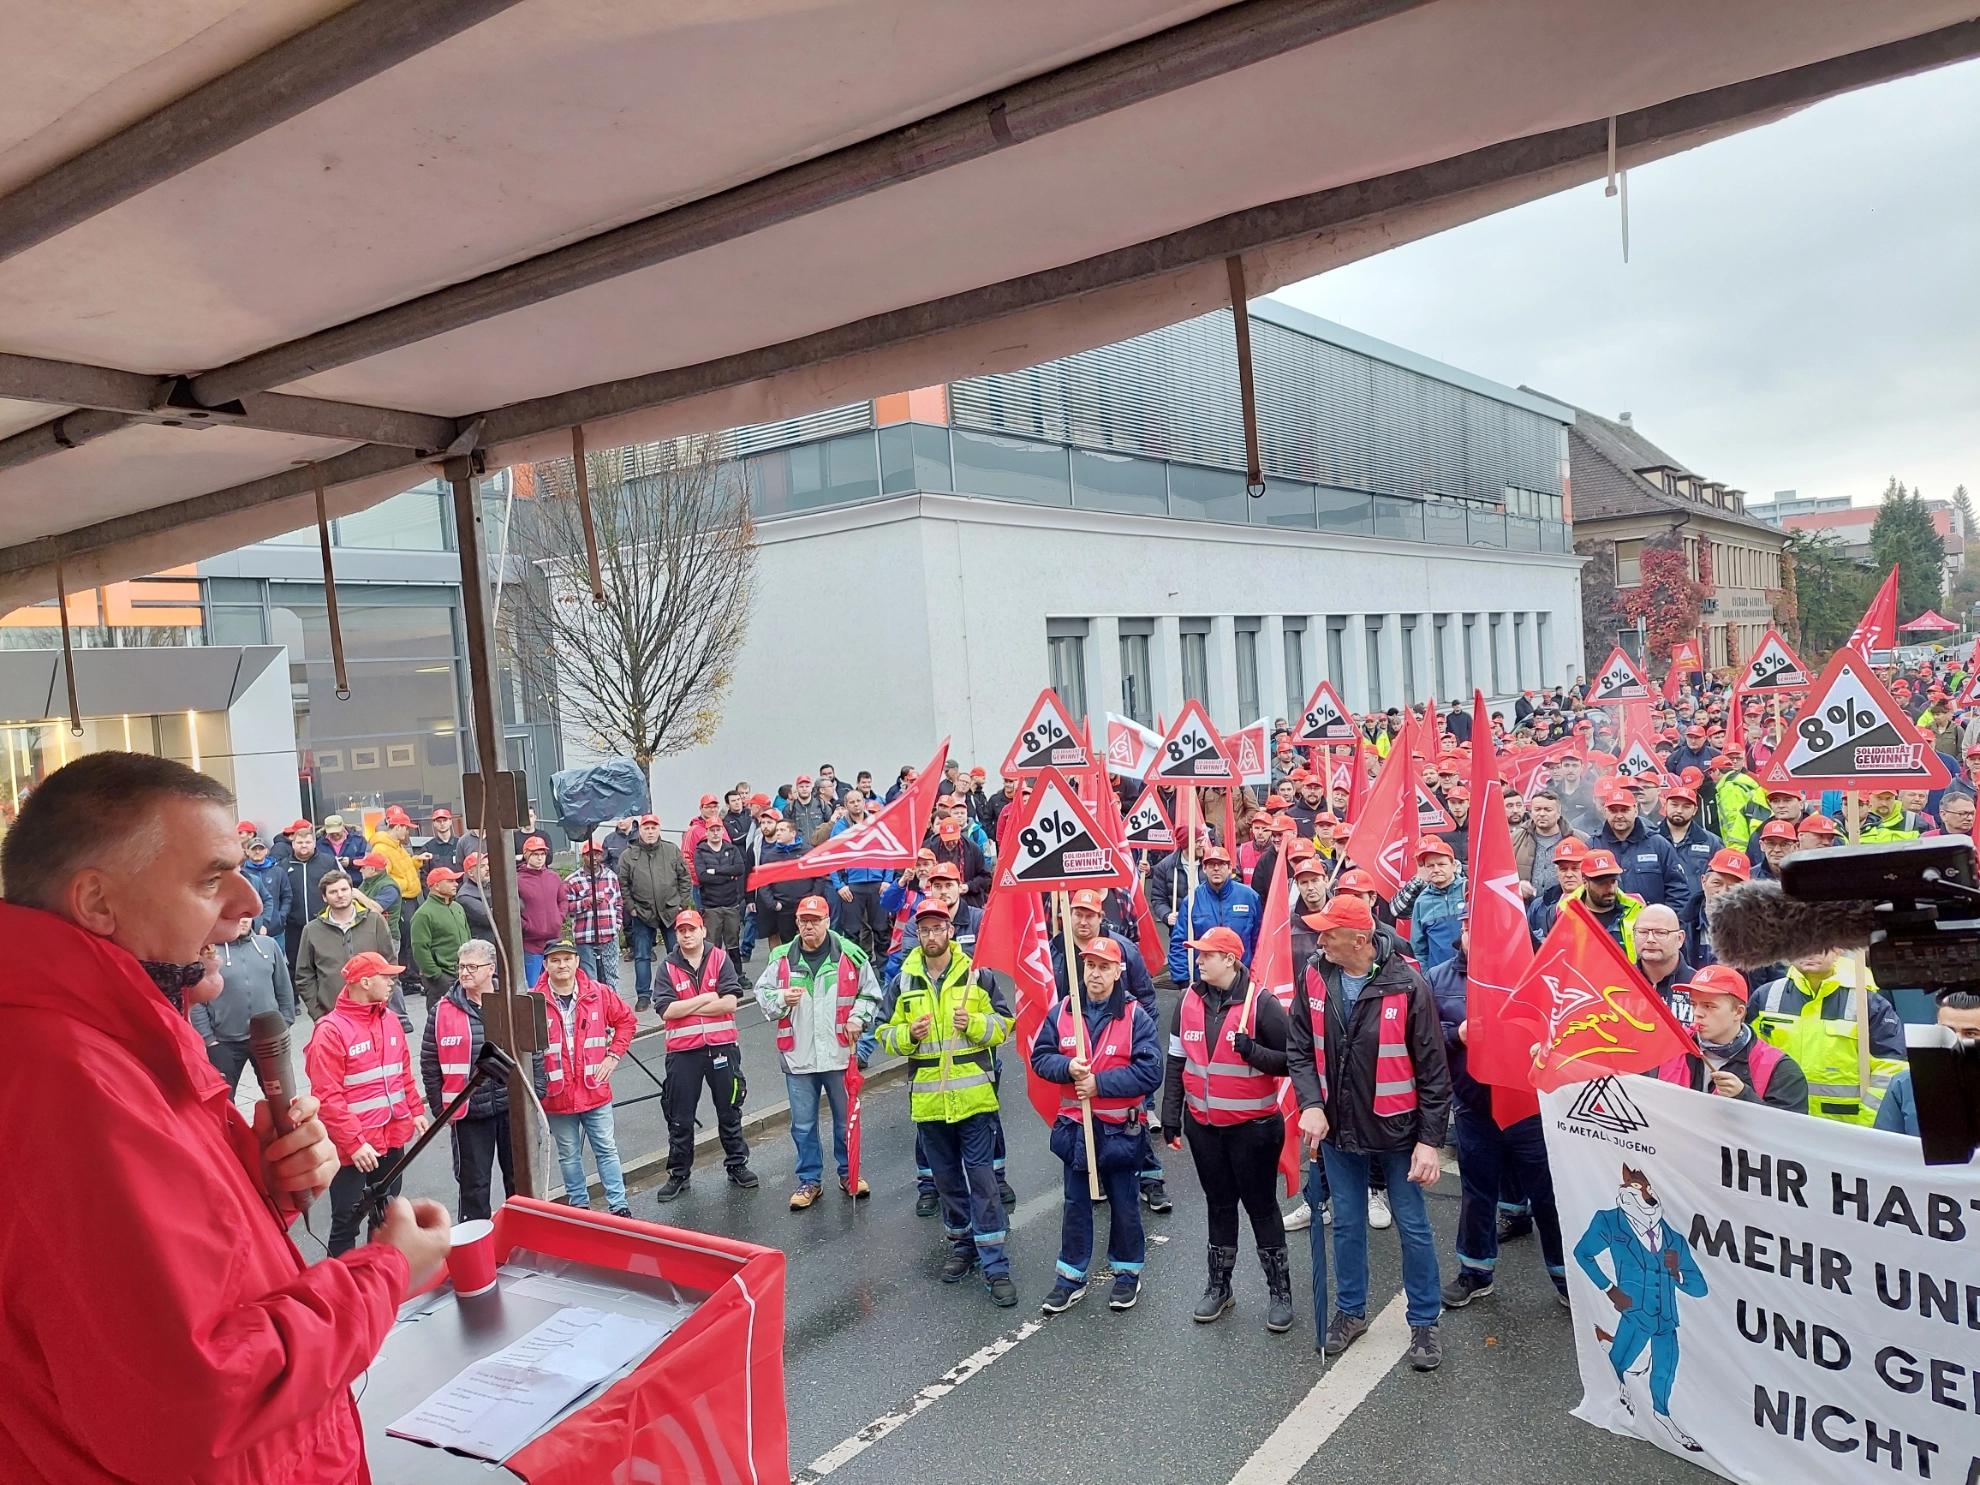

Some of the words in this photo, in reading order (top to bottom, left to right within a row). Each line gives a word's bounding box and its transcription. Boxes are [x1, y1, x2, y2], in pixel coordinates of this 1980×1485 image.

[1752, 652, 1786, 677] 8%
[1600, 668, 1630, 689] 8%
[1306, 703, 1335, 728] 8%
[1799, 697, 1876, 752] 8%
[1022, 719, 1063, 753] 8%
[1166, 729, 1207, 762] 8%
[1856, 745, 1911, 754] SOLIDARITÄT
[1129, 808, 1158, 830] 8%
[1020, 809, 1076, 858] 8%
[1384, 1007, 1398, 1020] 8!
[348, 1040, 371, 1057] GEBT
[440, 1035, 463, 1047] GEBT
[1061, 1036, 1077, 1047] GEB
[1183, 1030, 1205, 1042] GEBT
[1105, 1044, 1117, 1055] 8!
[1557, 1120, 1567, 1131] IG
[1569, 1125, 1613, 1142] METALL
[1613, 1136, 1657, 1155] JUGEND
[1720, 1145, 1809, 1208] IHR
[1687, 1213, 1853, 1295] MEHR
[1736, 1298, 1852, 1371] UND
[1874, 1345, 1980, 1416] GE
[1753, 1383, 1940, 1480] NICHT
